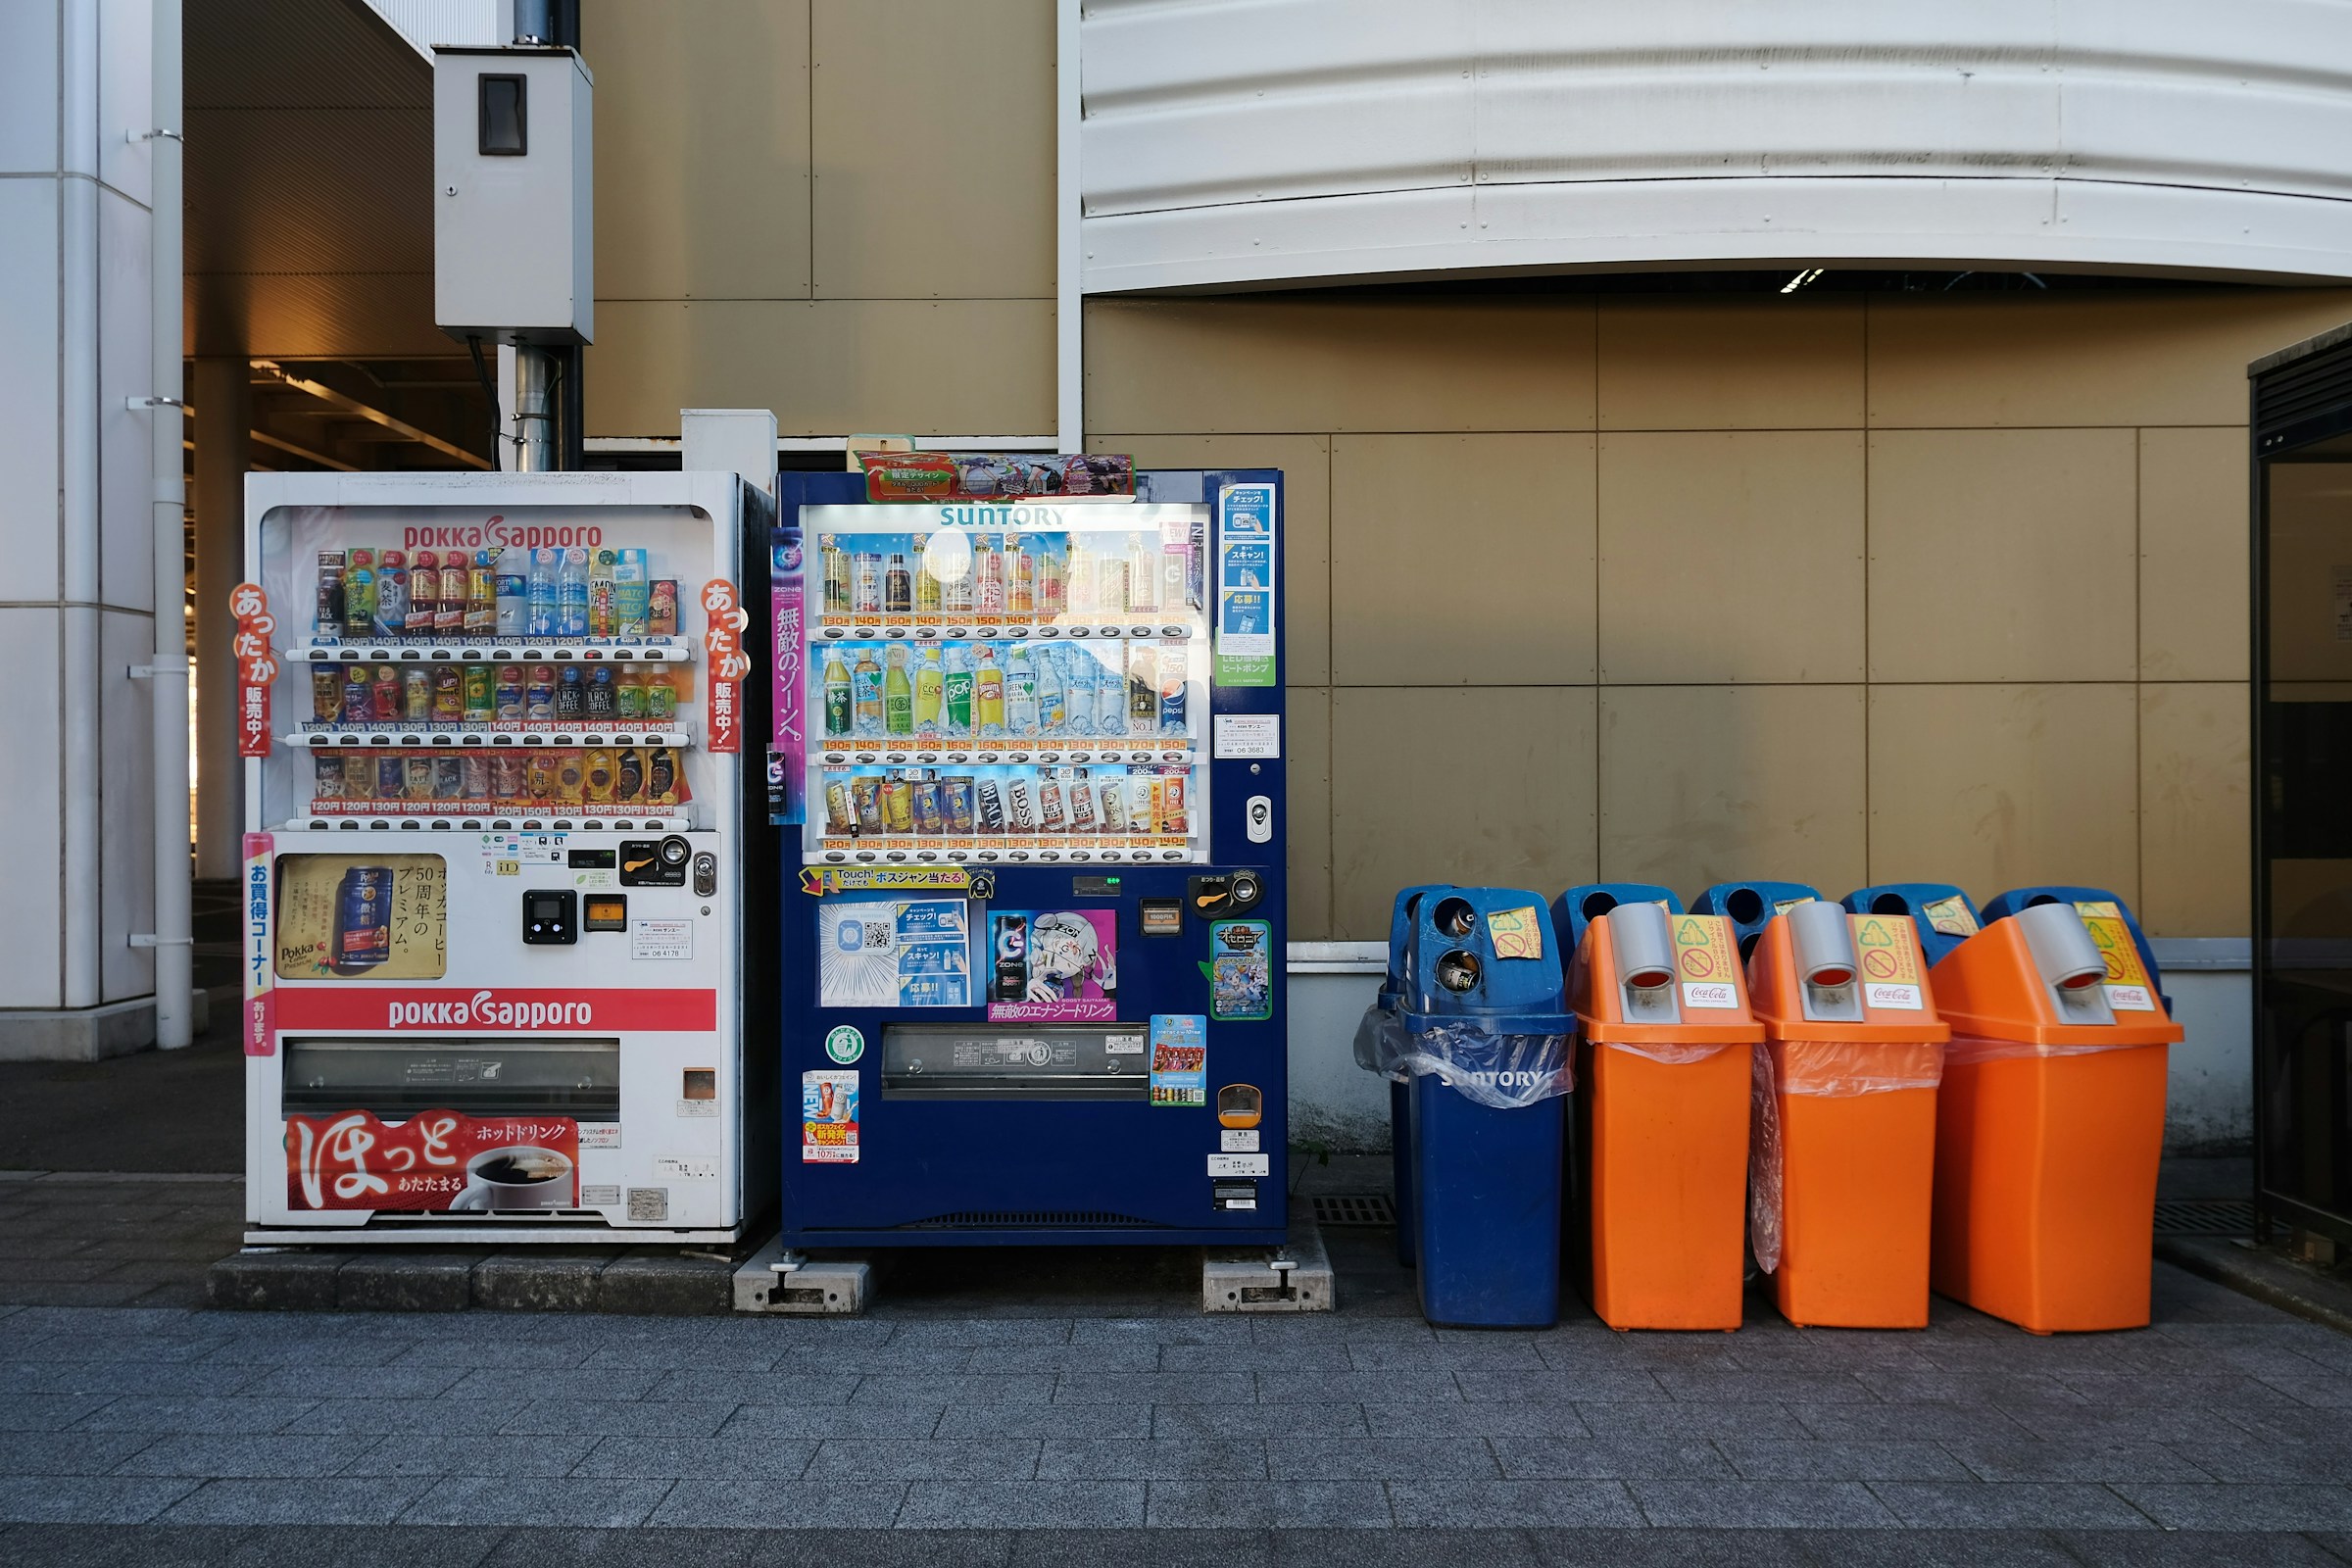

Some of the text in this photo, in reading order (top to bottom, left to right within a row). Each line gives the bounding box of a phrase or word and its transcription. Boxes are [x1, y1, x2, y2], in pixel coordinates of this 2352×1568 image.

[941, 507, 1067, 525] SUNTORY
[1234, 595, 1260, 604] 応募!!
[1006, 616, 1033, 625] 140円
[235, 588, 274, 682] あったか
[705, 583, 744, 677] あったか
[340, 636, 368, 646] 150円
[370, 636, 400, 646] 140円
[401, 636, 430, 646] 140円
[431, 636, 460, 646] 140円
[462, 636, 490, 646] 140円
[493, 636, 521, 646] 140円
[523, 636, 552, 646] 120円
[554, 636, 582, 646] 120円
[1222, 663, 1269, 673] ヒートポンプ
[776, 608, 802, 742] 無敵のゾーンへ。
[827, 691, 848, 704] 特茶
[714, 682, 731, 744] 販売中!
[1162, 707, 1184, 715] pepsi
[245, 686, 263, 749] 販売中!
[305, 722, 332, 732] 120円
[337, 722, 365, 732] 140円
[368, 722, 396, 732] 140円
[398, 722, 426, 732] 130円
[428, 722, 457, 732] 130円
[459, 722, 488, 732] 130円
[492, 721, 520, 732] 140円
[523, 721, 551, 732] 140円
[554, 721, 582, 732] 140円
[584, 721, 612, 732] 140円
[614, 721, 643, 732] 140円
[645, 721, 673, 732] 140円
[825, 741, 851, 750] 190円
[855, 741, 881, 750] 140円
[887, 741, 912, 750] 150円
[917, 741, 942, 750] 160円
[946, 741, 972, 750] 160円
[978, 741, 1004, 750] 160円
[1008, 741, 1033, 750] 160円
[1038, 741, 1064, 750] 130円
[1068, 741, 1095, 750] 130円
[1099, 741, 1125, 750] 130円
[1129, 741, 1155, 750] 170円
[1160, 741, 1186, 750] 150円
[312, 802, 339, 811] 120円
[342, 802, 369, 811] 120円
[371, 802, 400, 811] 130円
[402, 802, 429, 811] 120円
[431, 802, 460, 811] 120円
[462, 802, 490, 811] 120円
[493, 807, 522, 815] 120円
[522, 807, 551, 815] 150円
[554, 807, 582, 815] 130円
[584, 805, 612, 814] 130円
[612, 805, 641, 814] 130円
[644, 805, 673, 814] 130円
[981, 787, 1003, 829] BLACK
[1014, 787, 1033, 827] BOSS
[1152, 794, 1161, 819] 新発売
[825, 840, 851, 849] 120円
[857, 840, 882, 849] 130円
[887, 840, 912, 849] 130円
[917, 840, 943, 849] 130円
[947, 840, 973, 849] 130円
[977, 840, 1004, 849] 130円
[1008, 838, 1034, 847] 130円
[1038, 838, 1064, 847] 130円
[1069, 838, 1095, 847] 130円
[1100, 838, 1125, 847] 130円
[1130, 838, 1156, 847] 140円
[837, 869, 874, 879] Touch!
[876, 872, 965, 884] ボスジャン当たる!
[414, 867, 434, 937] 50周年の
[395, 866, 415, 954] プレミアム。
[250, 865, 268, 1047] お買得コーナー あります。
[281, 943, 314, 960] Pokka
[907, 952, 940, 960] スキャン!
[909, 982, 939, 993] 応募!!
[990, 1004, 1114, 1020] 無敵のエナジードリンク
[804, 1084, 819, 1119] NEW
[476, 1123, 566, 1143] ホットドリンク
[816, 1130, 847, 1140] 新発売
[296, 1114, 458, 1209] ほっと
[398, 1177, 462, 1193] あたたまる
